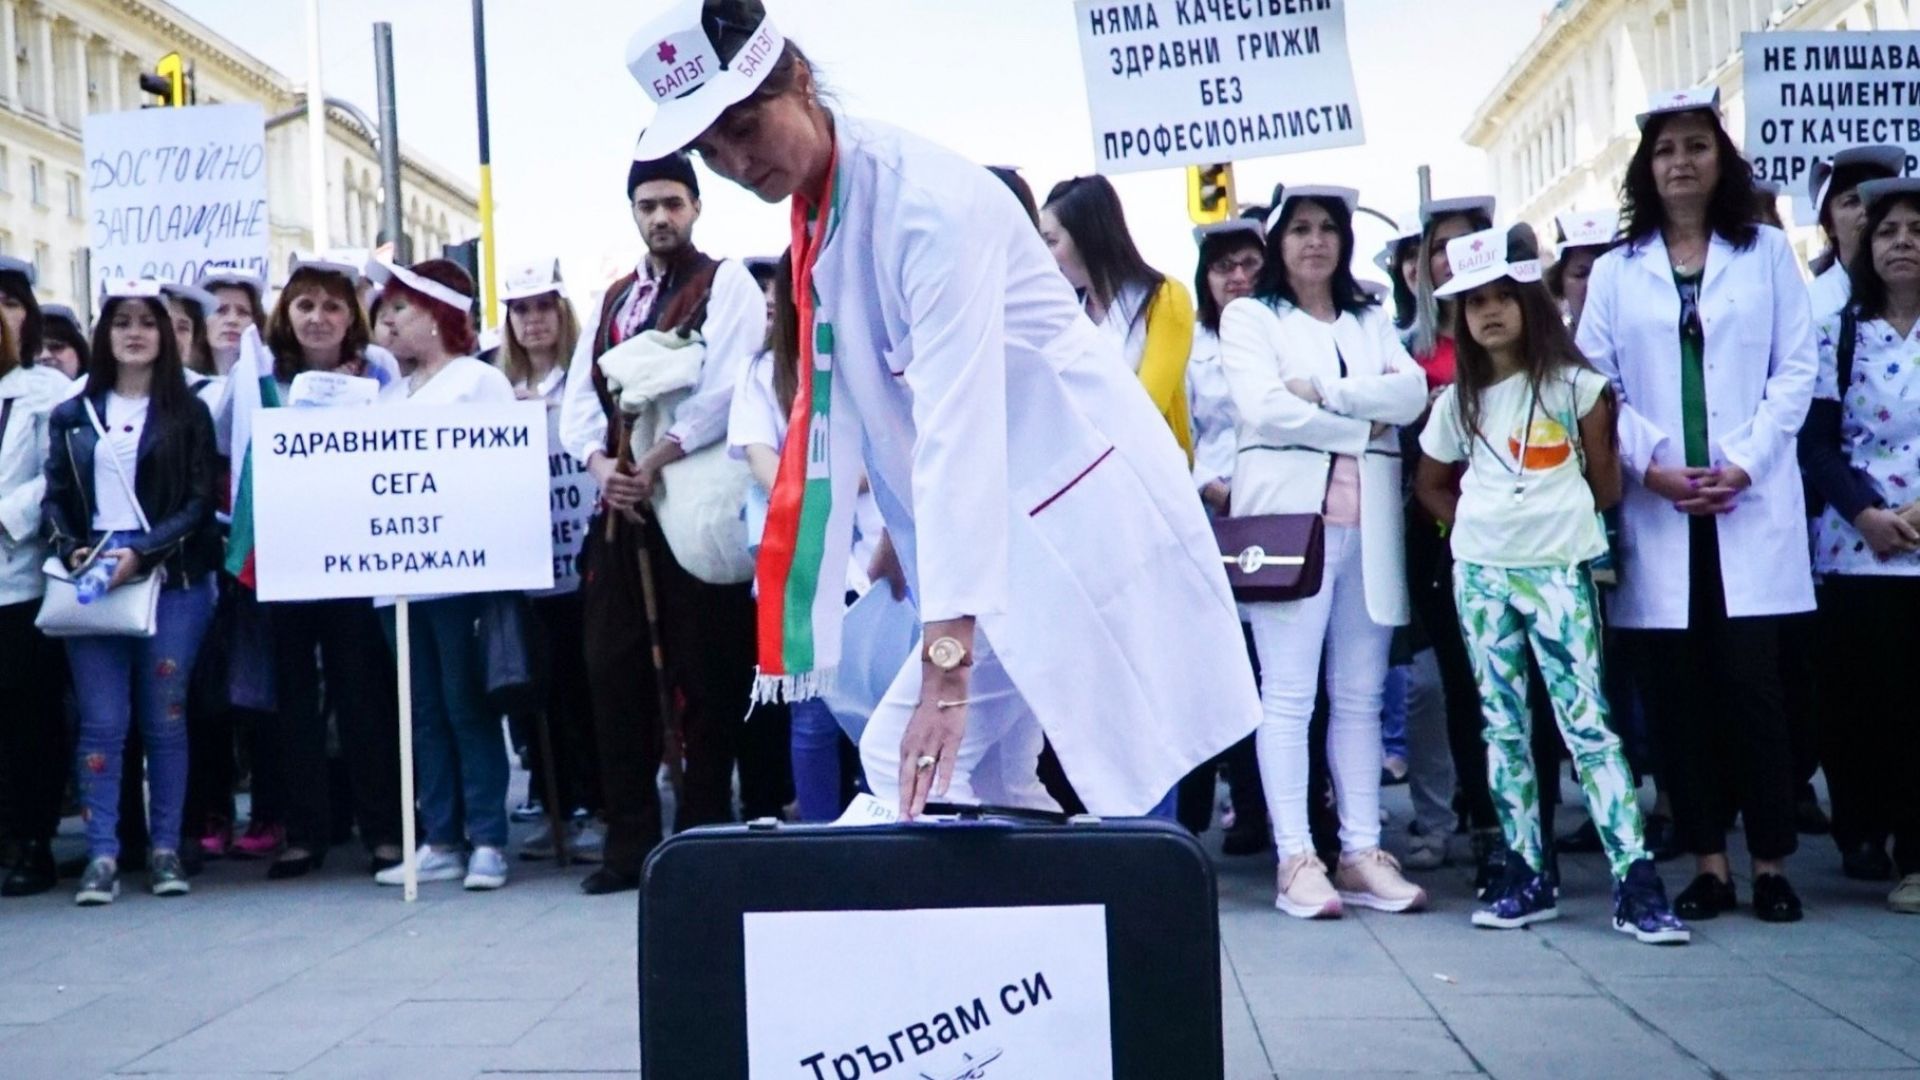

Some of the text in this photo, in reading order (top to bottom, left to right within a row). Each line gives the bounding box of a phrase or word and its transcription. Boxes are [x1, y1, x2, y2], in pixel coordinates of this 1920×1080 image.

[1090, 6, 1159, 36] НЯМА
[737, 28, 774, 78] БАПЗГ
[1109, 26, 1321, 78] ЗДРАВНИ ГРИЖИ
[1764, 45, 1920, 72] НЕ ЛИШАВА
[653, 54, 705, 98] БАПЗГ
[1199, 76, 1243, 106] БЕЗ
[1781, 82, 1920, 111] ПАЦИЕНТИ
[1103, 103, 1353, 160] ПРОФЕСИОНАЛИСТИ
[1761, 118, 1920, 145] ОТ КАЧЕСТВ
[91, 141, 264, 192] ДОСТОЙНО
[95, 199, 266, 250] ЗАПЛАЩАНЕ
[272, 426, 529, 458] ЗДРАВНИТЕ ГРИЖИ
[371, 472, 438, 496] СЕГА
[370, 515, 444, 536] БАПЗГ
[325, 550, 487, 573] РК КЪРДЖАЛИ
[799, 971, 1053, 1080] Тръгвам си
